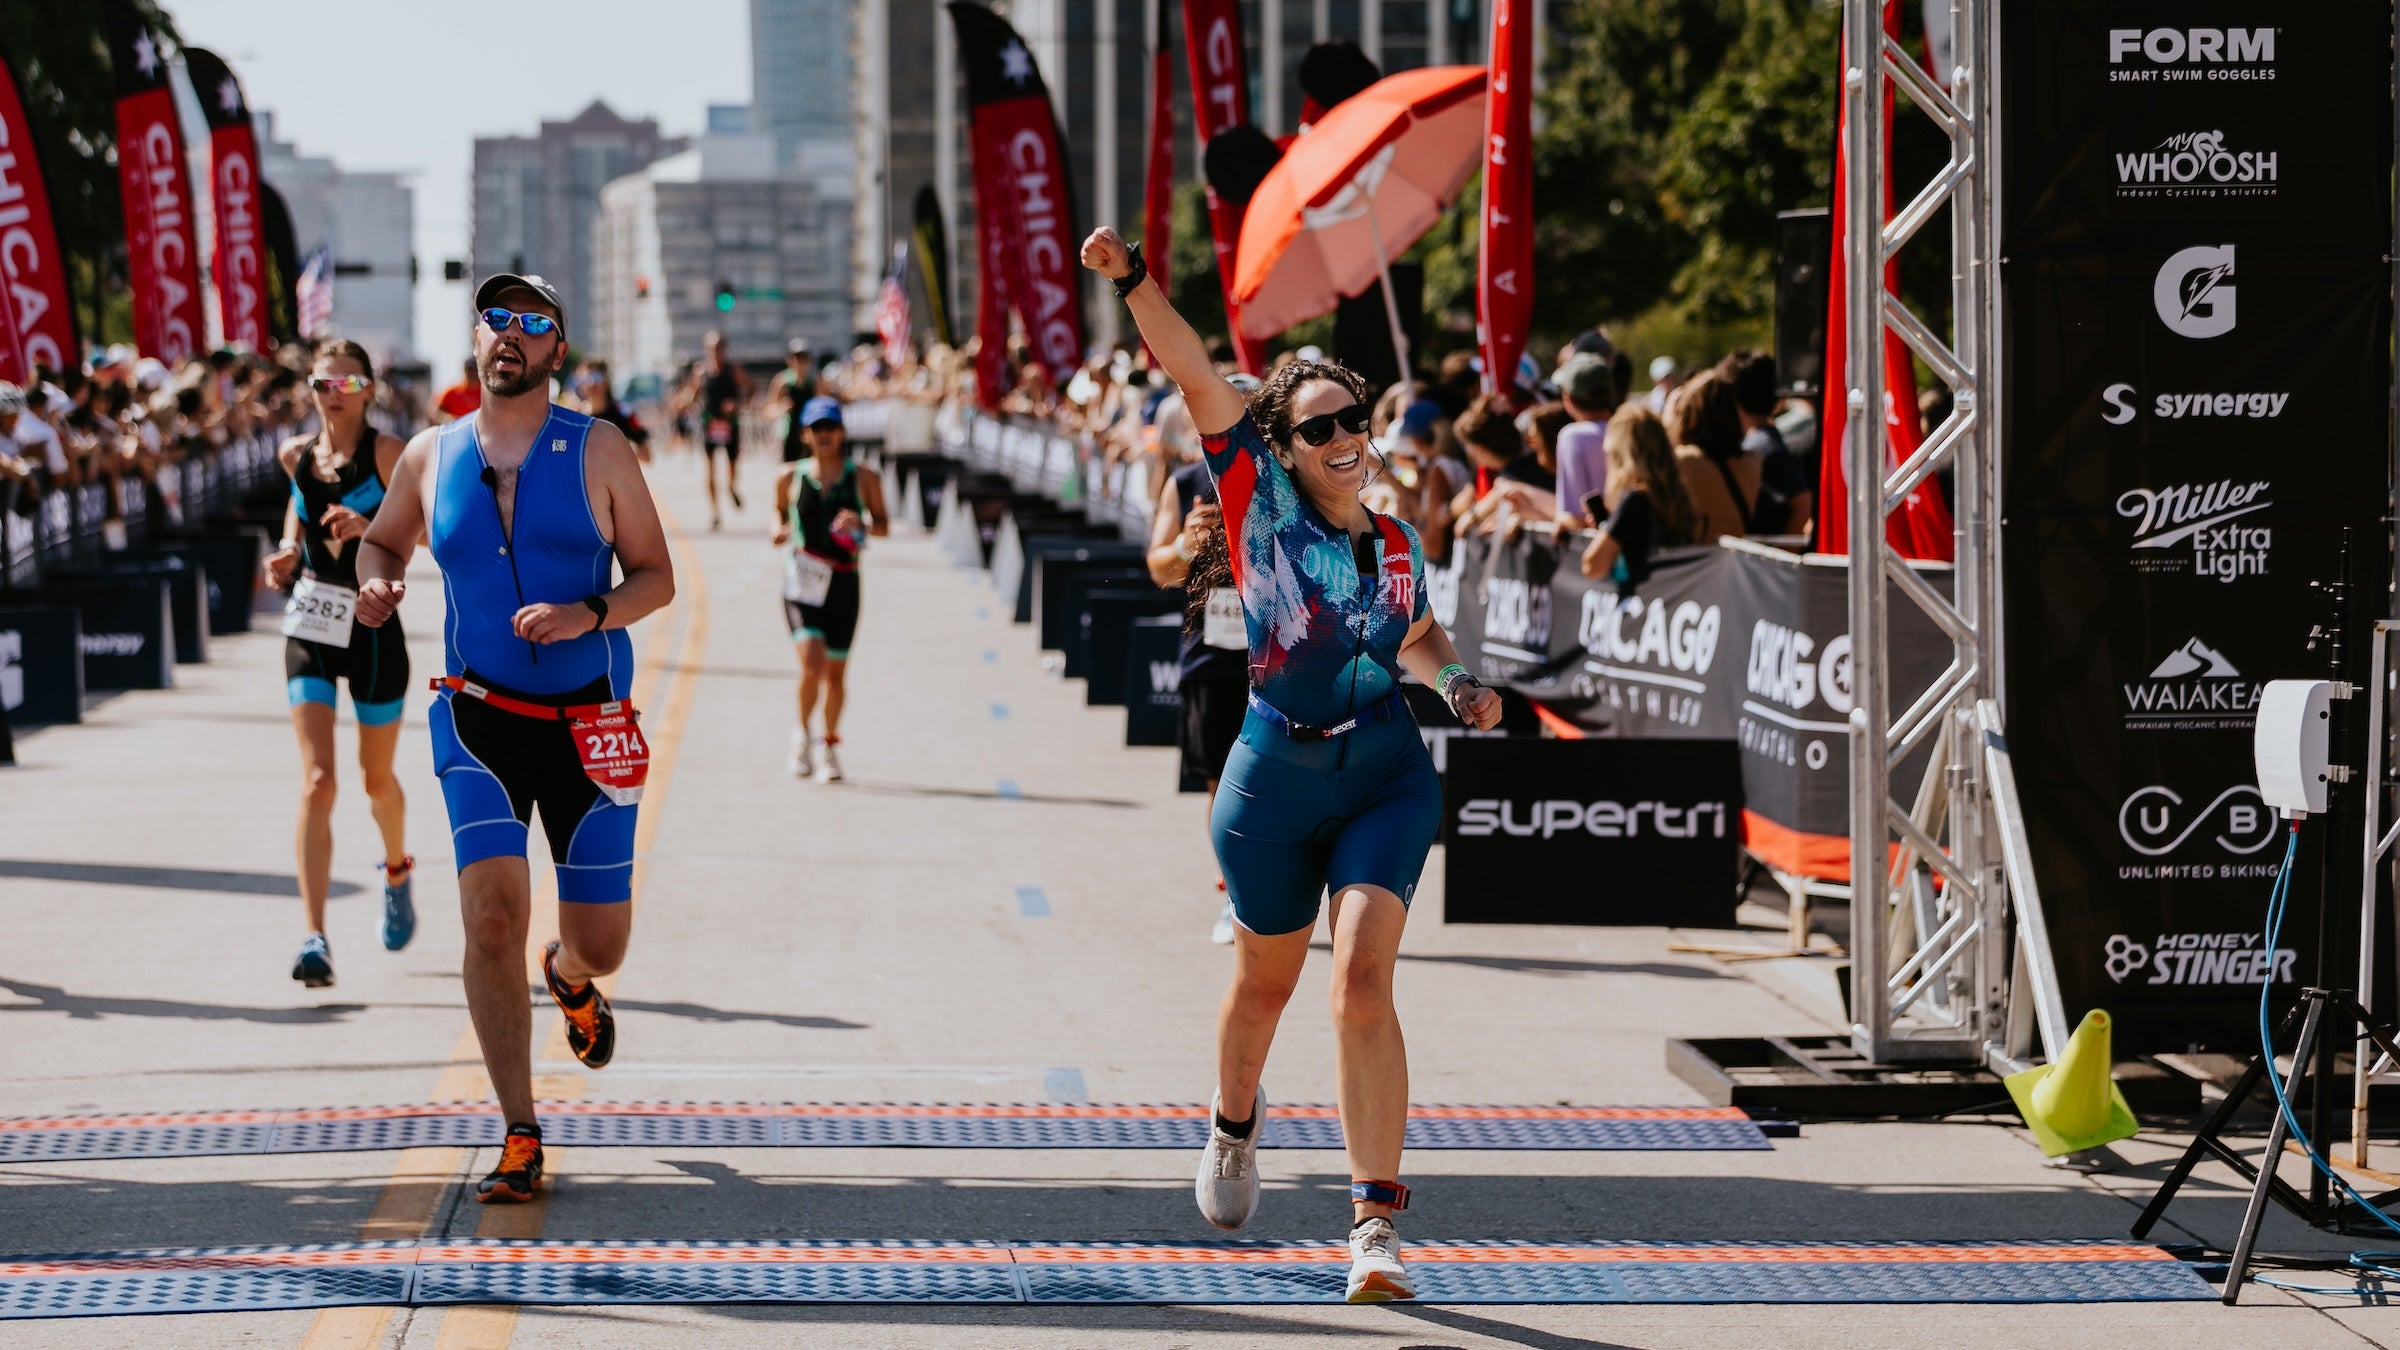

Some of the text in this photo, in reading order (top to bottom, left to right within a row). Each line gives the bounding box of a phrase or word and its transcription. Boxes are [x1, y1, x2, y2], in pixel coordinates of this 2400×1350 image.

[2109, 28, 2275, 63] FORM
[2109, 69, 2276, 81] SMART SWIM GOGGLES
[2115, 151, 2277, 182] WHOOSH
[2166, 189, 2216, 198] Cycling
[2224, 188, 2277, 196] Solution
[2154, 392, 2289, 418] synergy
[2116, 479, 2270, 537] Miller
[2193, 523, 2271, 550] Extra
[2195, 550, 2266, 583] Light
[2174, 720, 2216, 729] VOLCANIC
[586, 731, 643, 760] 2214
[2140, 806, 2169, 835] U
[2230, 806, 2257, 834] B
[2119, 864, 2279, 879] UNLIMITED BIKING
[2156, 933, 2260, 949] HONEY
[2147, 949, 2297, 985] STINGER
